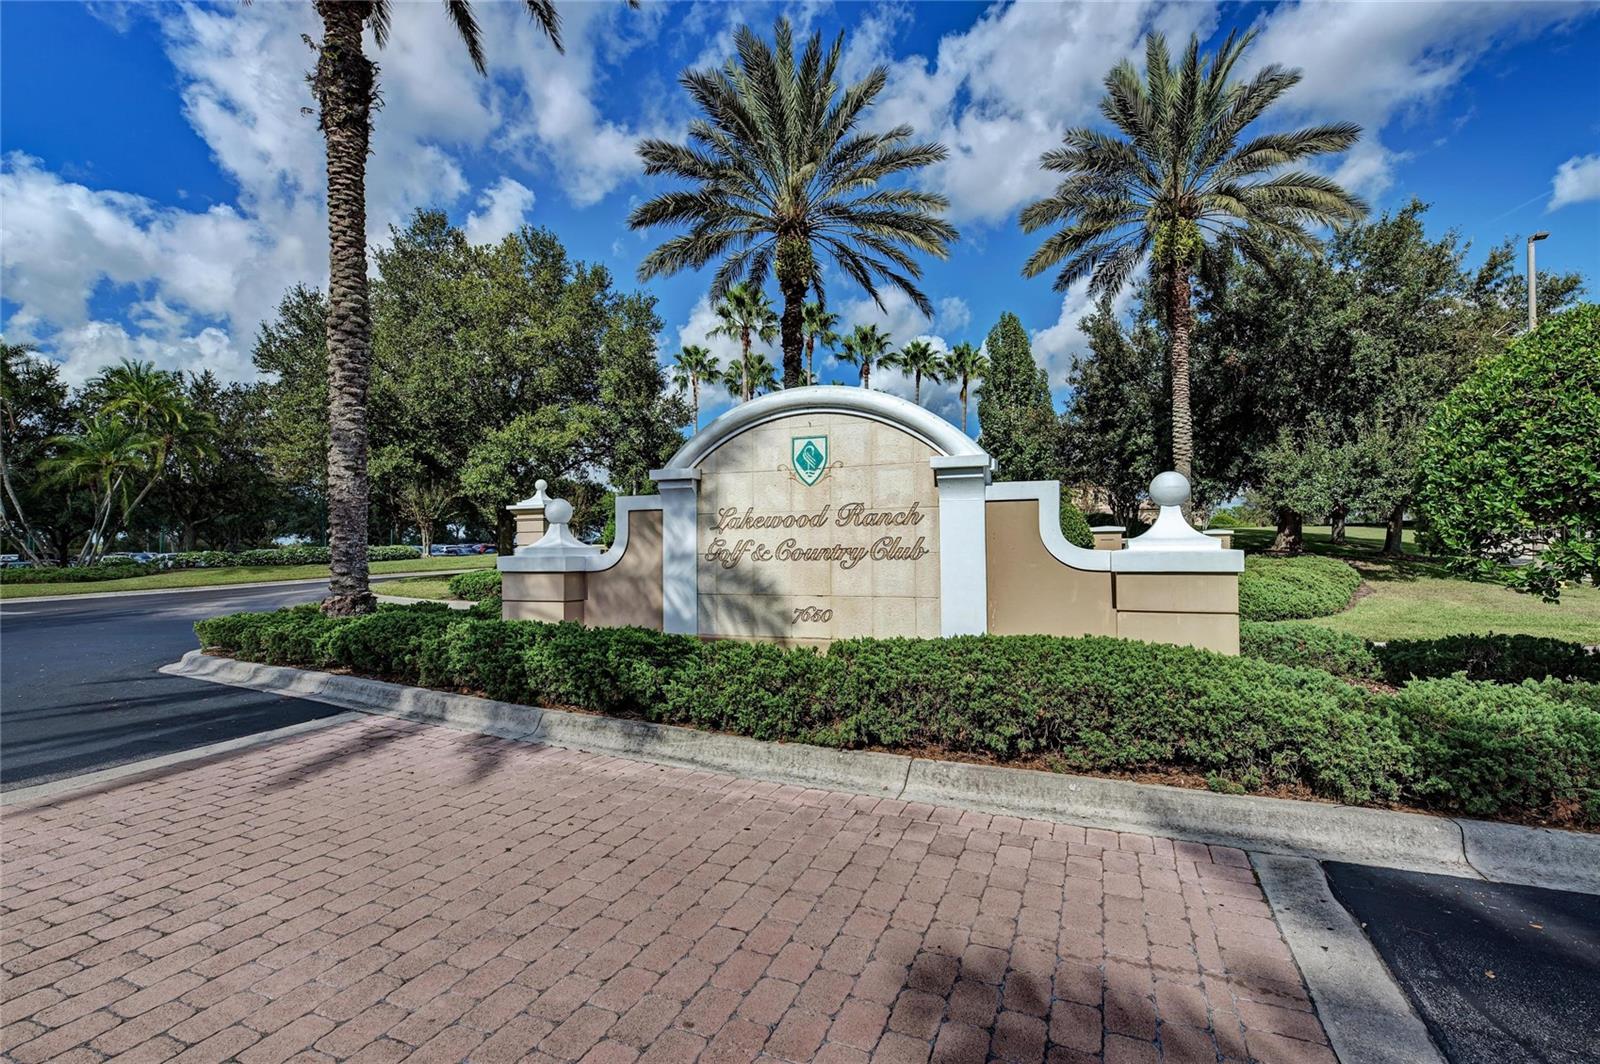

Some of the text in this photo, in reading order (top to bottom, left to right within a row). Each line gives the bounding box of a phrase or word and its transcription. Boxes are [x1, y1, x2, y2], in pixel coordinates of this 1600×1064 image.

[710, 502, 925, 534] Lakewood Ranch
[705, 536, 929, 569] Golf & Country Club
[791, 606, 833, 624] 7650
